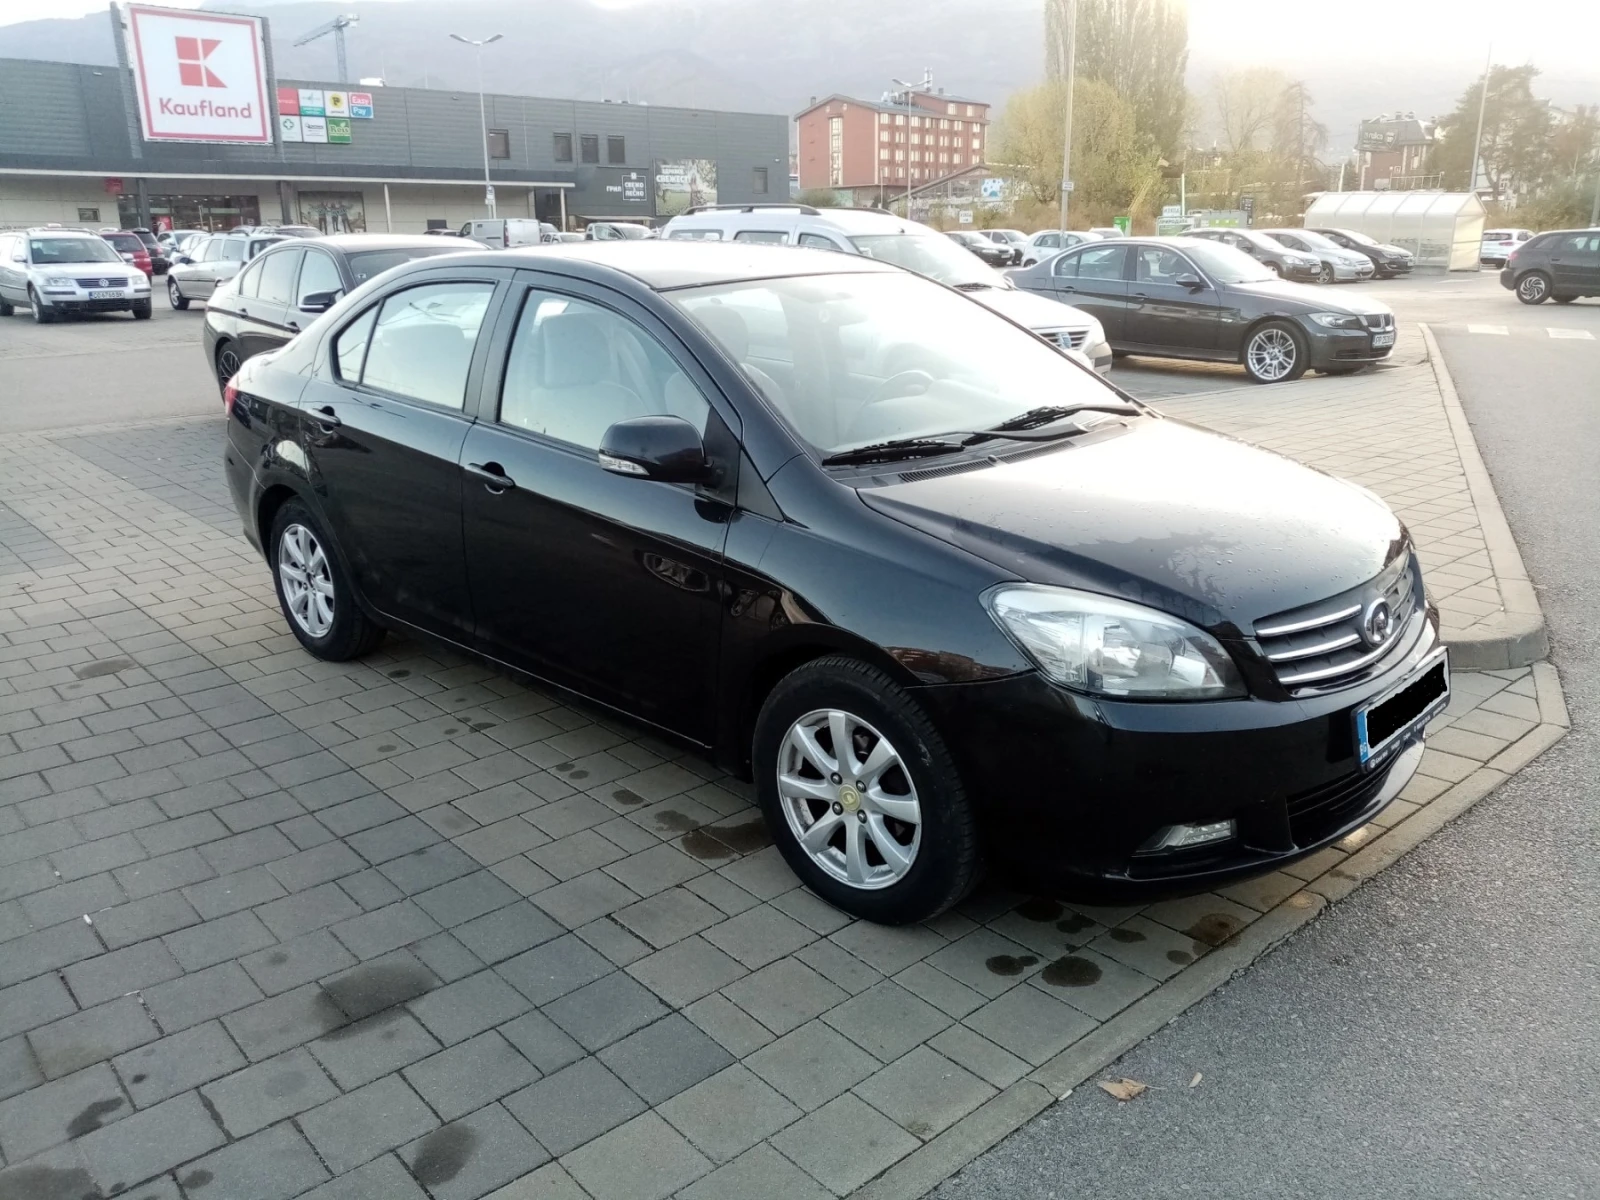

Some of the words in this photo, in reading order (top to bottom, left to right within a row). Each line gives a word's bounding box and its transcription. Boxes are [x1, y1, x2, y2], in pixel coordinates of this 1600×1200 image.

[351, 95, 370, 104] Easy
[158, 97, 253, 119] Kaufland
[353, 106, 367, 115] Pay
